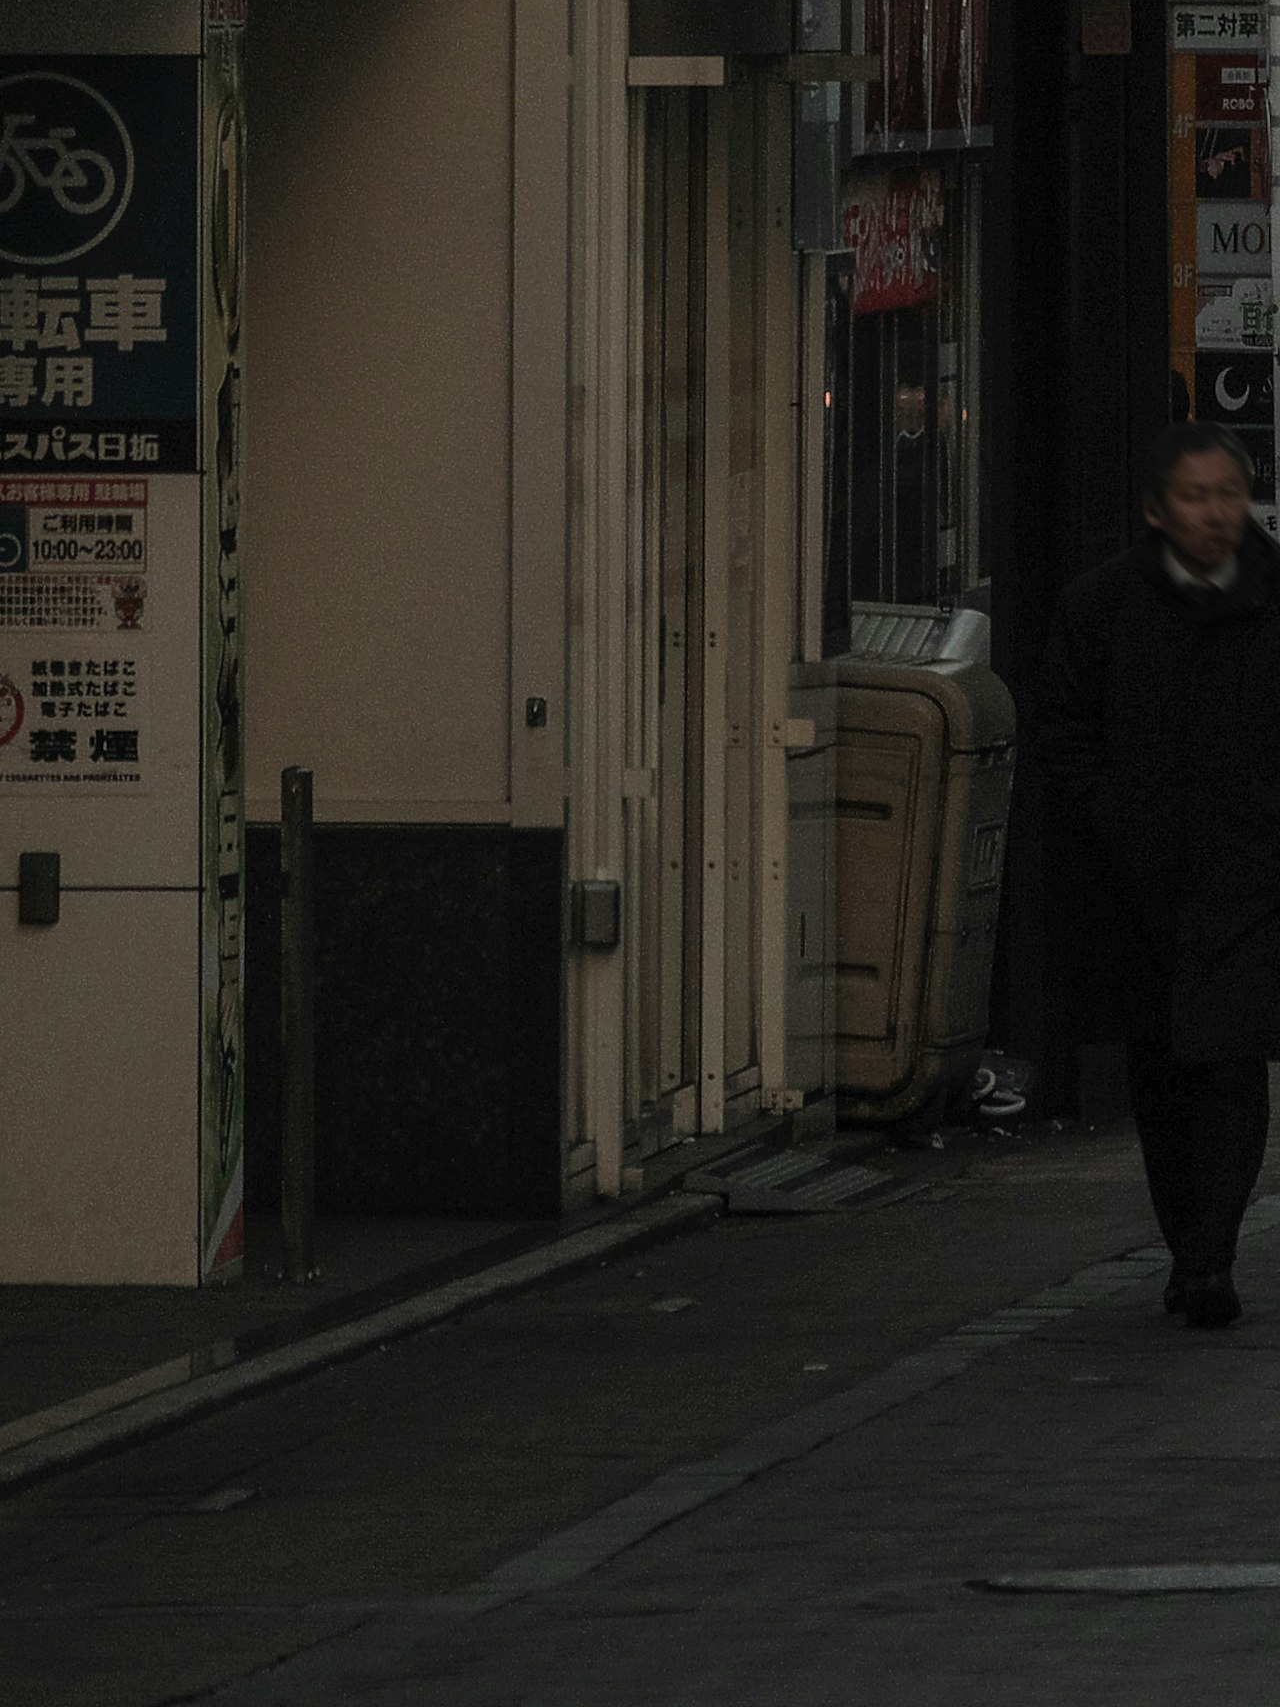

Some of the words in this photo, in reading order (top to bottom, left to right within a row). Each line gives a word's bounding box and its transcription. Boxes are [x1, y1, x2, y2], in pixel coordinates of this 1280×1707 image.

[0, 425, 160, 462] スパス日拓
[40, 701, 128, 718] 電子たばこ
